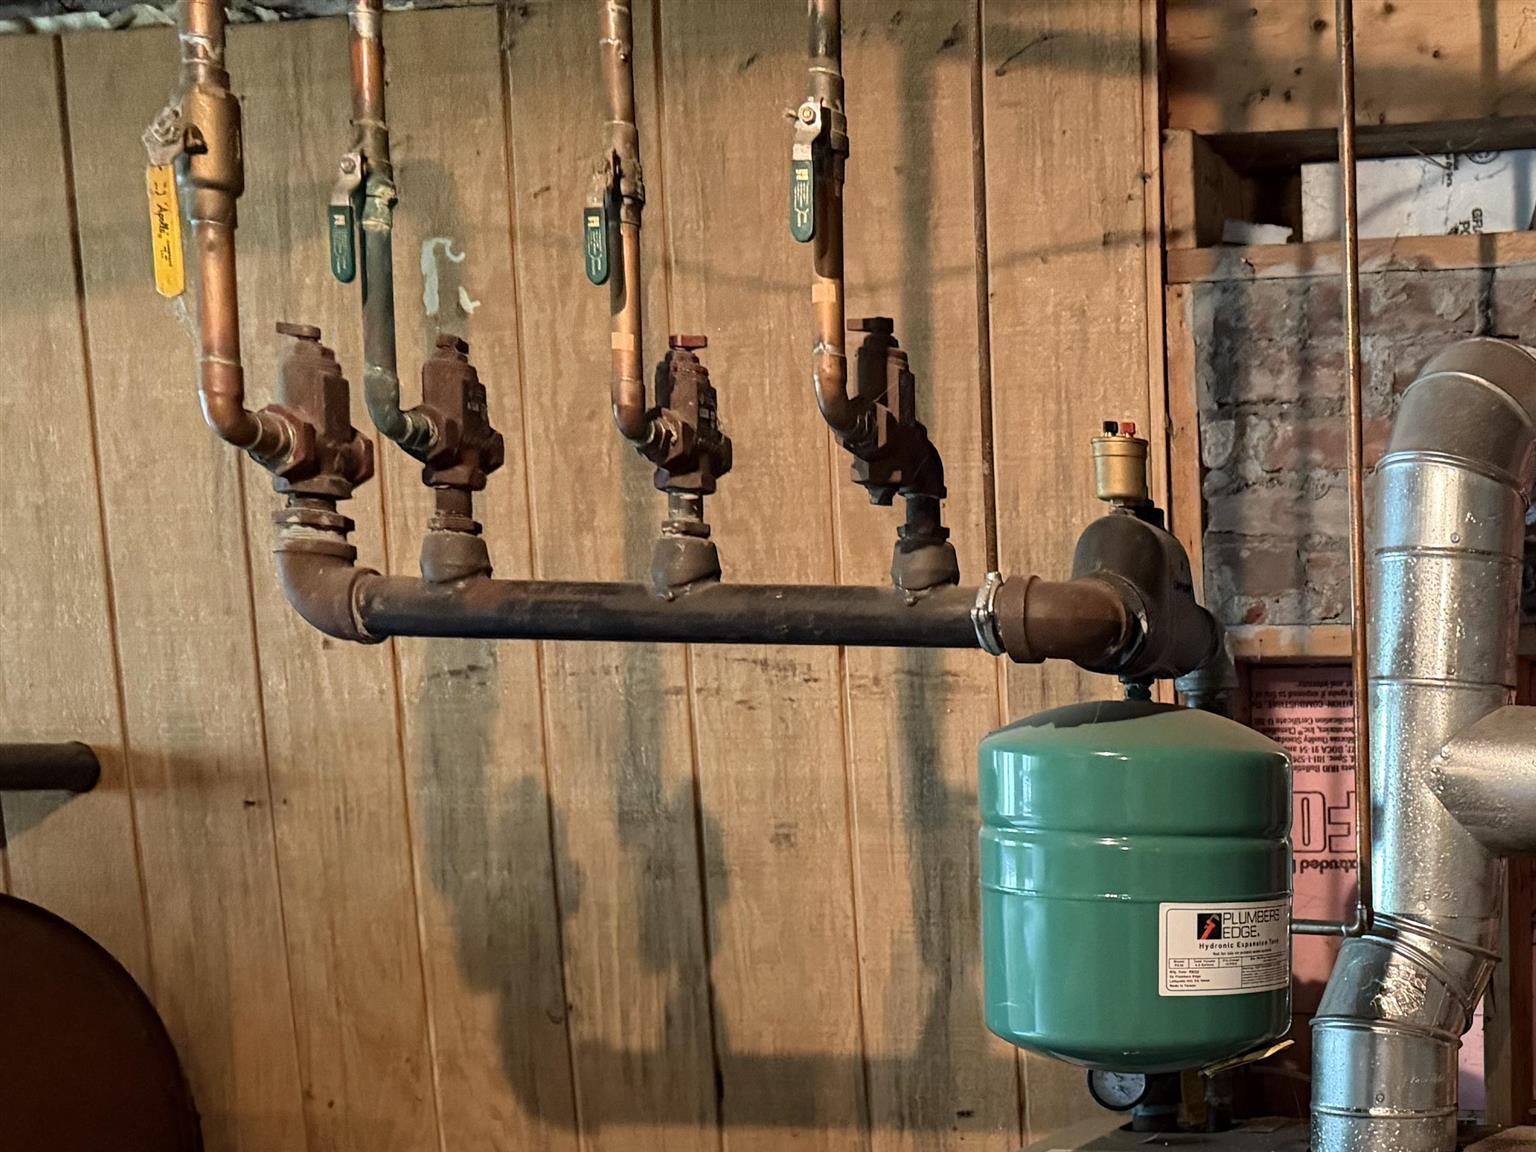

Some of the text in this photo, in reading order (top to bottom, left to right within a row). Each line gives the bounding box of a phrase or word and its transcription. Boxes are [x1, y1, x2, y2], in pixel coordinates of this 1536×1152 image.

[1300, 860, 1356, 875] xtruded
[1223, 909, 1279, 925] PLUMBERS
[1199, 942, 1234, 950] Hydronic
